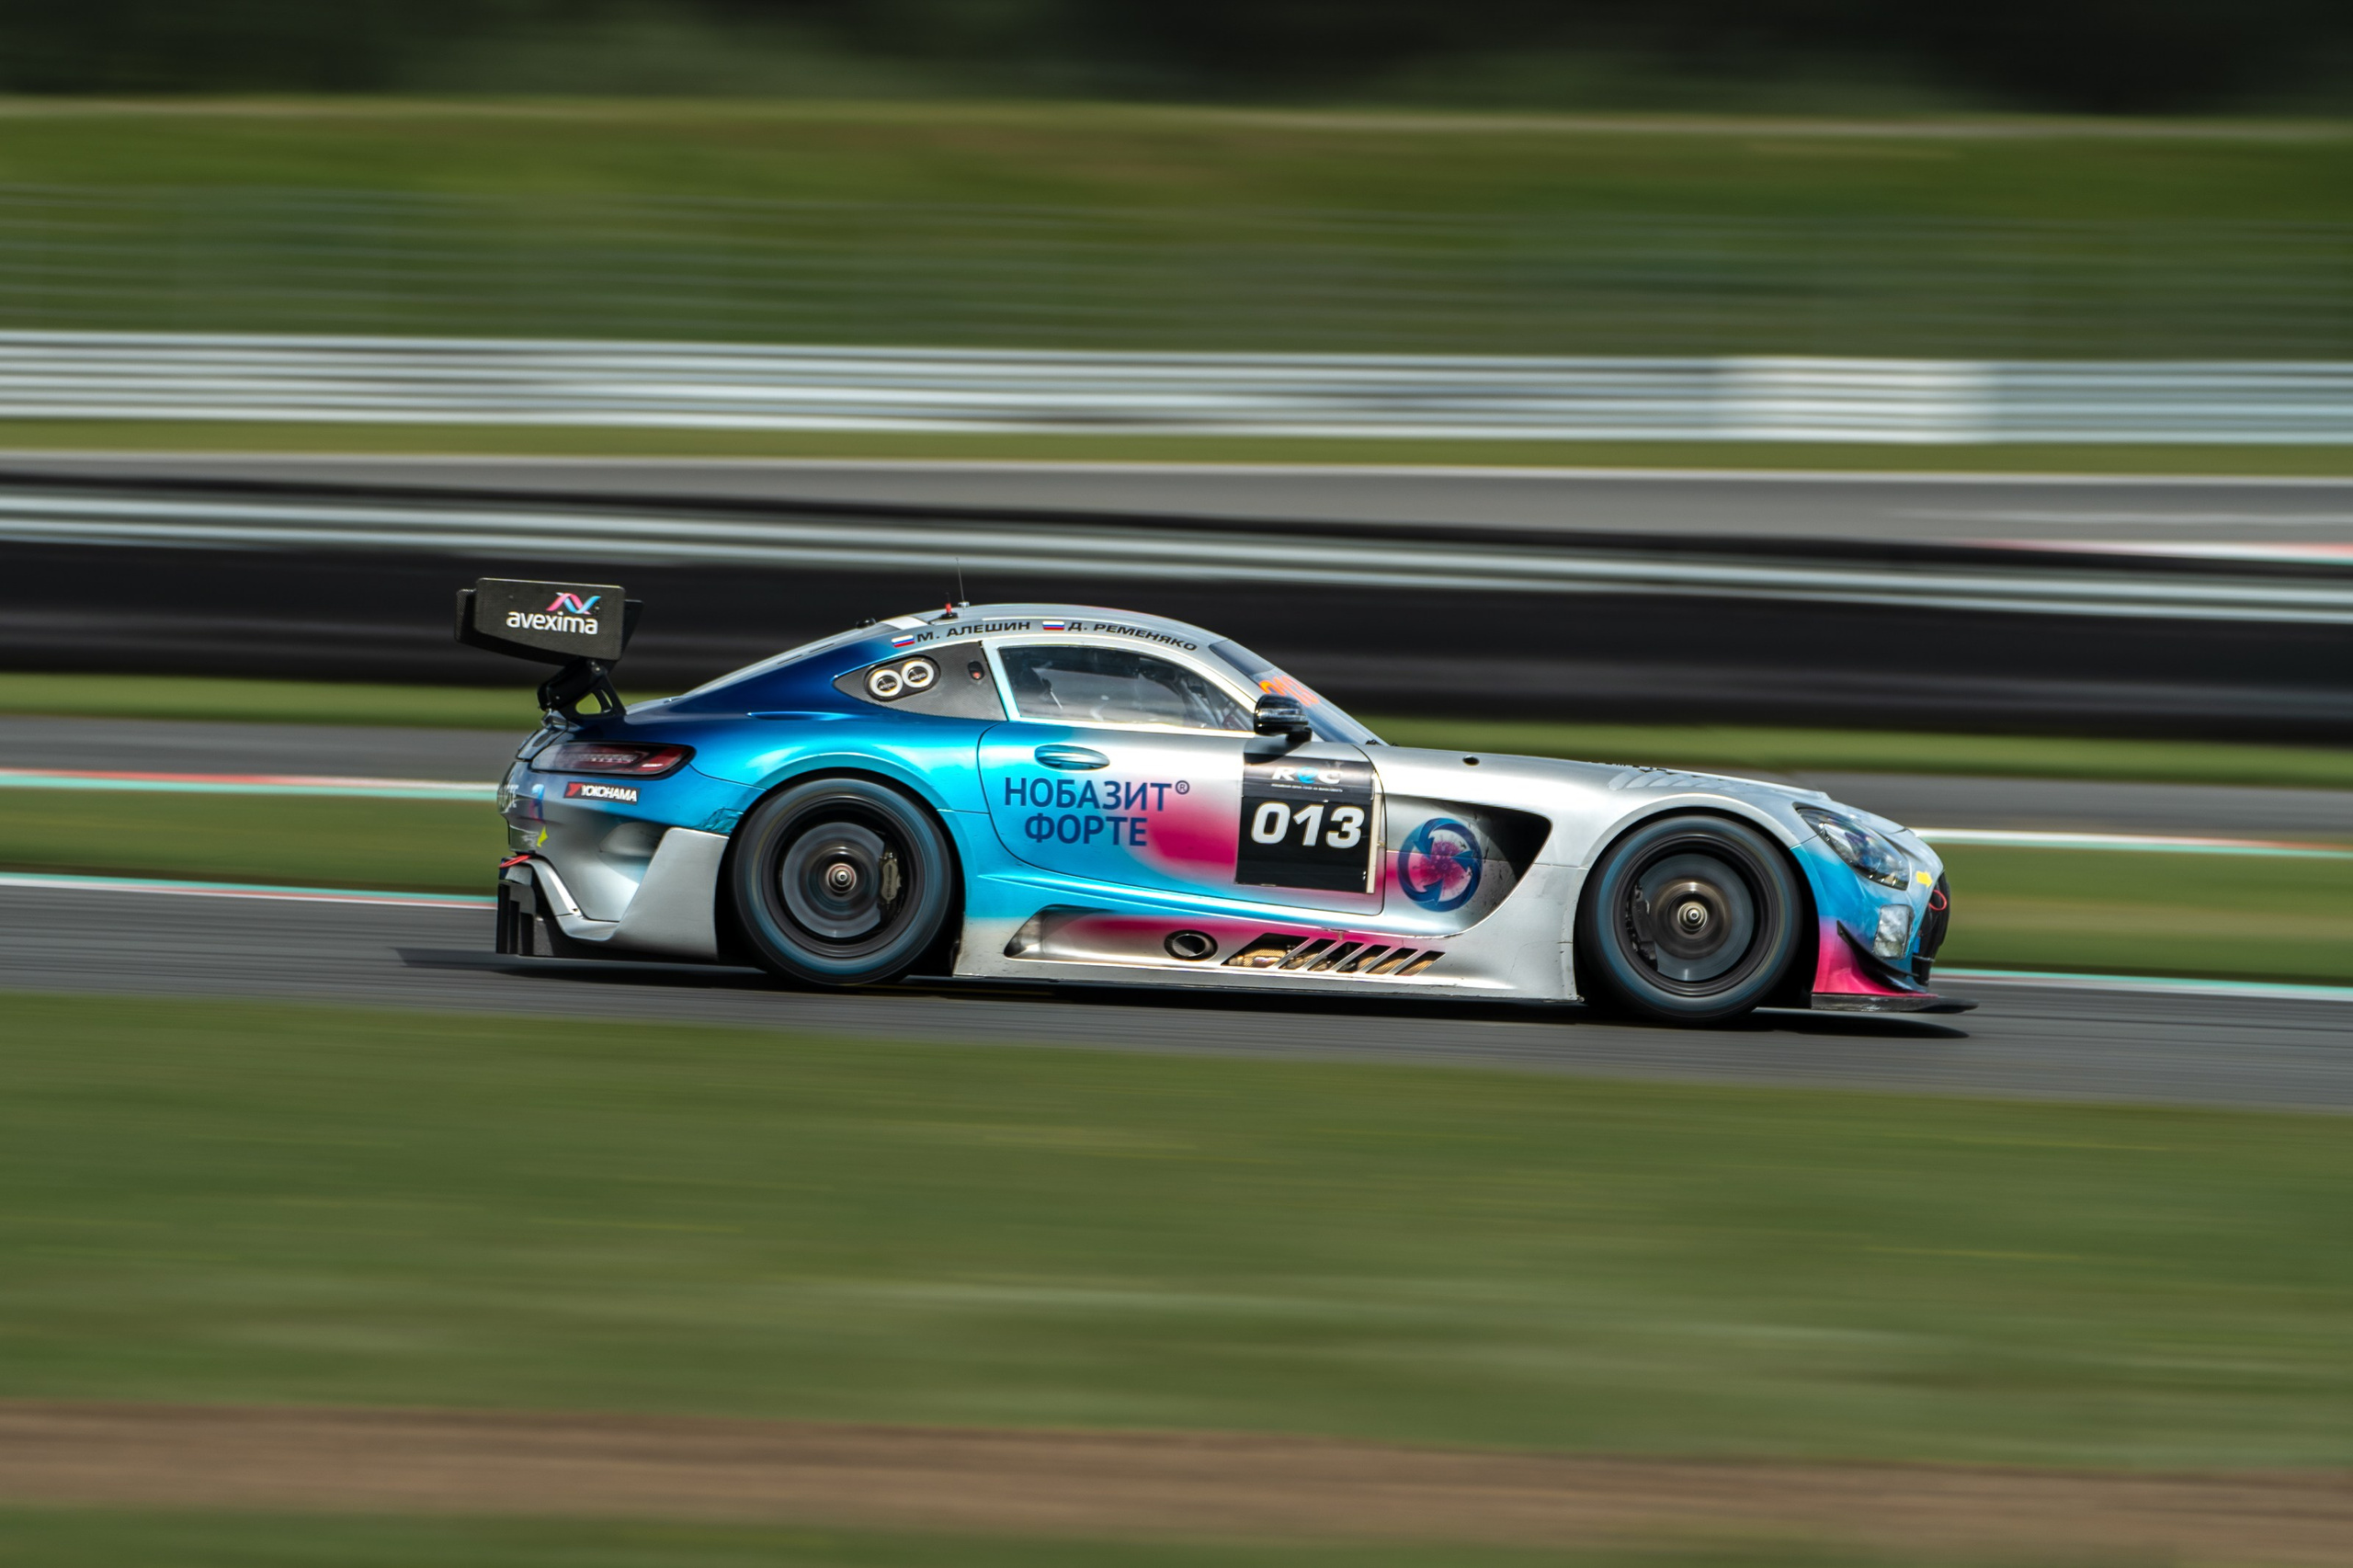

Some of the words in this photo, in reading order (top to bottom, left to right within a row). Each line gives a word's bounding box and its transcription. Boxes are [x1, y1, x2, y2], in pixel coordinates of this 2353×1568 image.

[506, 611, 598, 635] avexima
[916, 631, 940, 642] М.
[946, 621, 1030, 637] АЛЕШИН
[1067, 621, 1087, 631] Д.
[1093, 623, 1198, 651] РЕМЕНЯКО
[581, 784, 638, 802] YOKOHAMA
[1024, 812, 1148, 846] ФОРТЕ
[1250, 801, 1365, 848] 013
